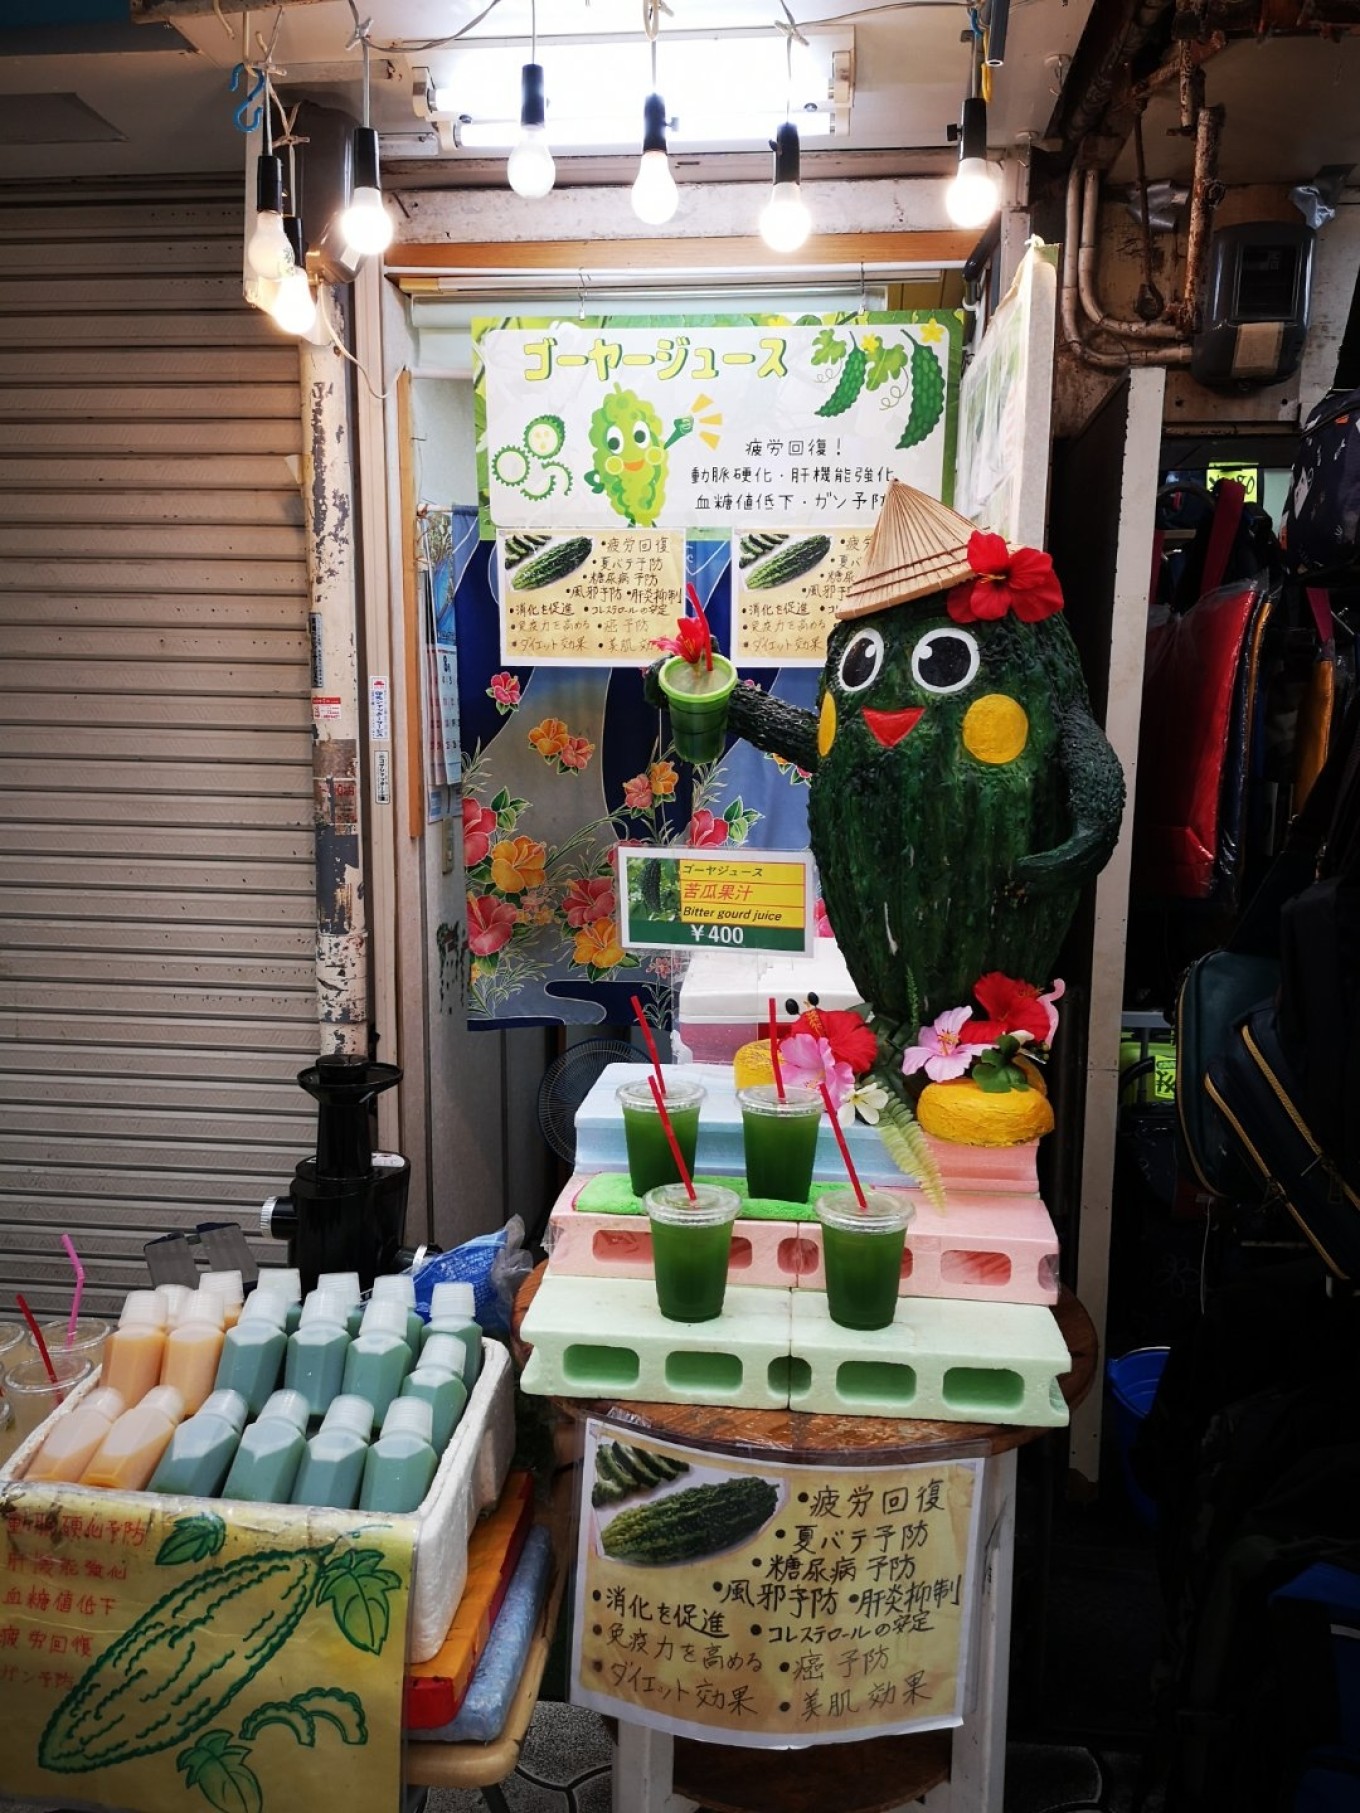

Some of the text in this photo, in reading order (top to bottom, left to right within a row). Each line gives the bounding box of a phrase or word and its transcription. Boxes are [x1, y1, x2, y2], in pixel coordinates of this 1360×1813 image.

[523, 336, 788, 382] ゴーヤージュース
[745, 437, 842, 456] 疲労回復！
[606, 536, 671, 554] 疲労回復
[682, 864, 764, 878] ゴーヤジュース
[683, 882, 754, 901] 苦瓜果汁
[683, 906, 783, 922] Bitter gourd juice
[690, 924, 744, 944] ¥400
[808, 1477, 946, 1519] 疲労回復
[792, 1519, 930, 1555] 夏バテ予防
[764, 1554, 917, 1585] 糖尿病予防
[4, 1587, 117, 1616] 血糖値低下
[720, 1573, 963, 1620] 風邪予防 肝炎抑制
[605, 1586, 936, 1644] 消化を促進 コレステロールの安定
[606, 1622, 763, 1672] 免疫力を高める
[610, 1659, 934, 1722] ダイエット効果 美肌効果
